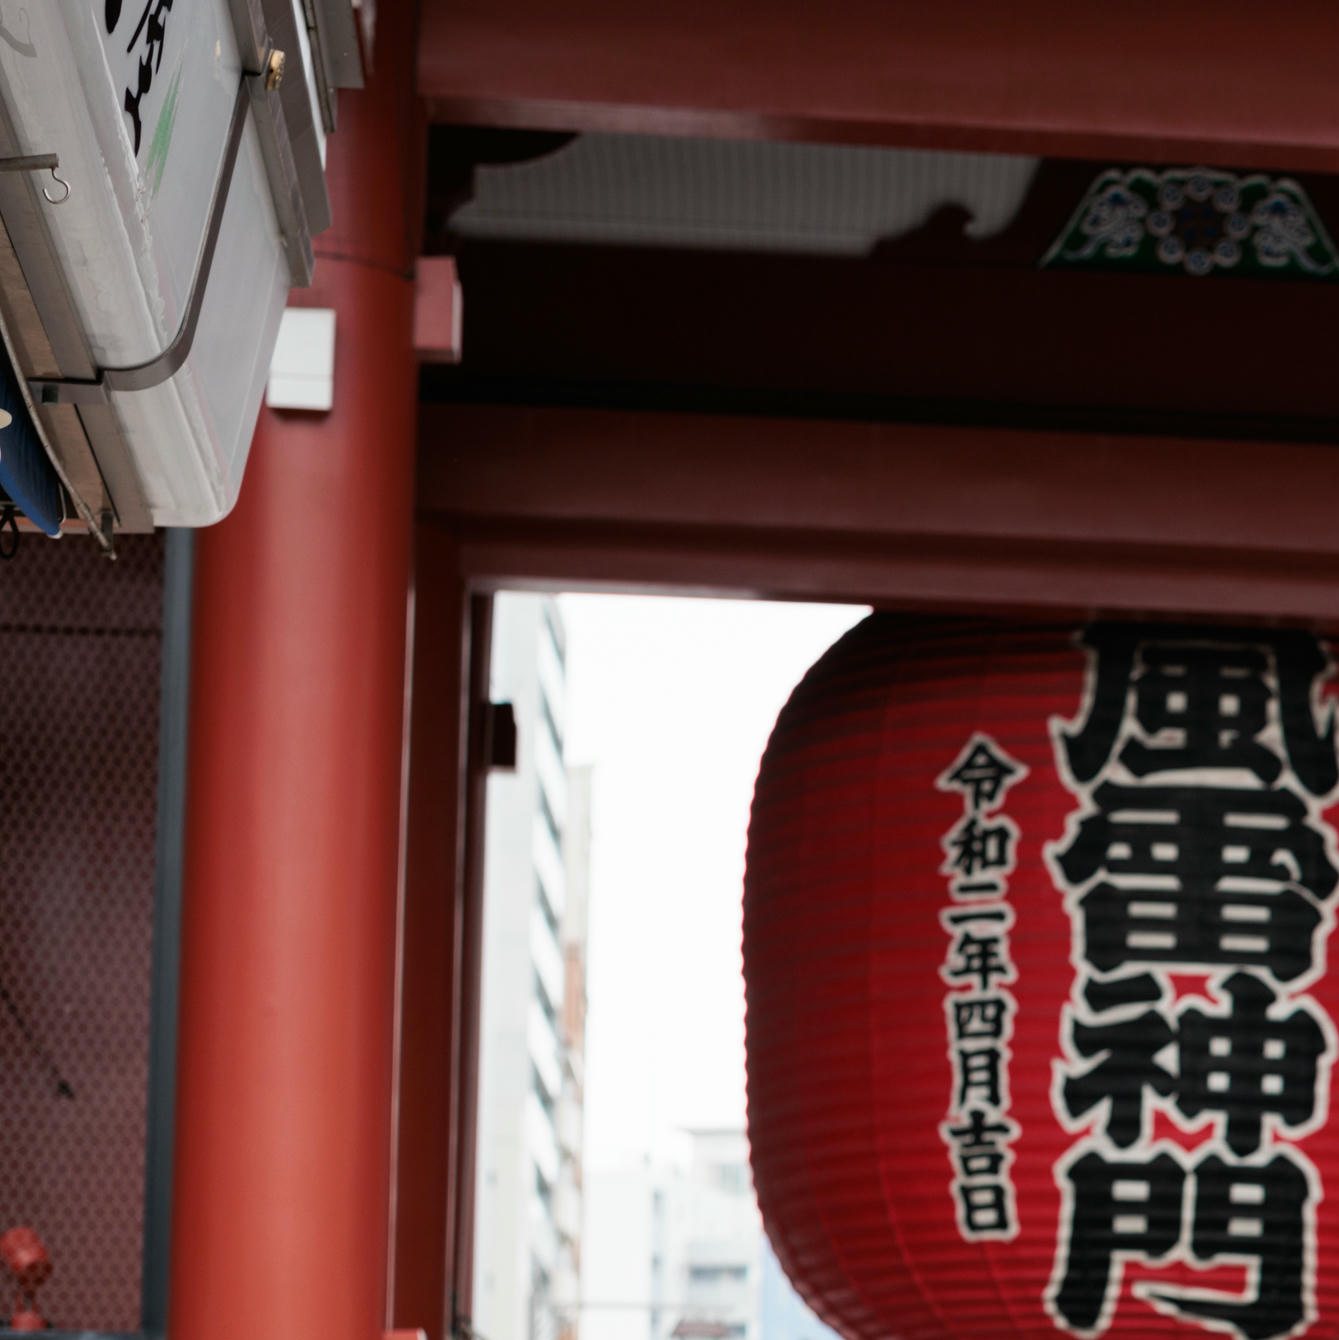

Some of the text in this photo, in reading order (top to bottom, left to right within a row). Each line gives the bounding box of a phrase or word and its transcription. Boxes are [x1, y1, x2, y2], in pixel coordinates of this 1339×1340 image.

[937, 732, 1028, 1243] 令和二年四月吉日
